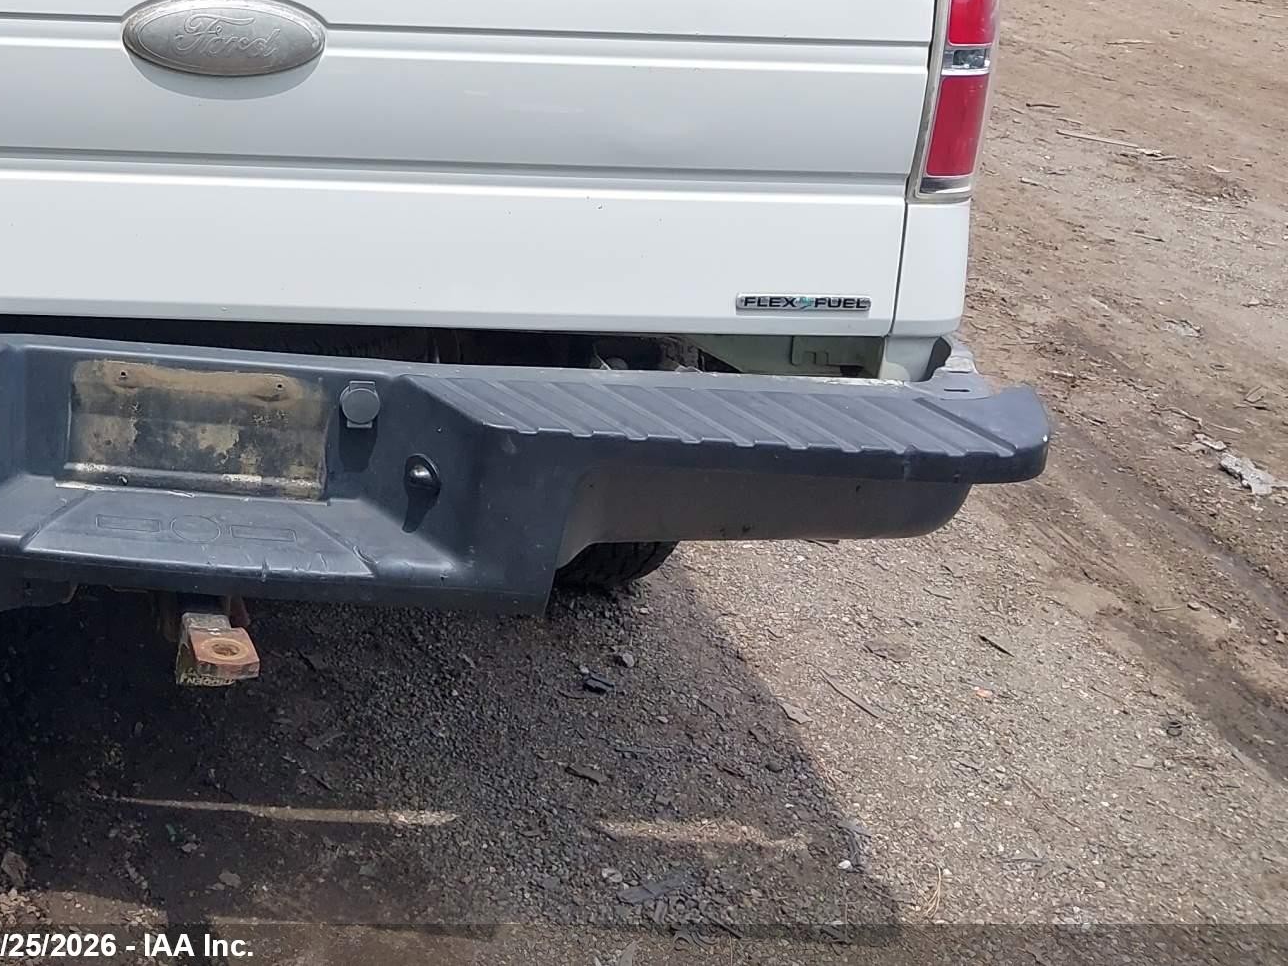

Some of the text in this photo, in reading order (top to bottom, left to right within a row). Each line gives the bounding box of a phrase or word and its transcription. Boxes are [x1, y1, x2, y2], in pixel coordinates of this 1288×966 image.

[175, 13, 281, 59] Ford
[743, 296, 868, 309] FLEX FUEL
